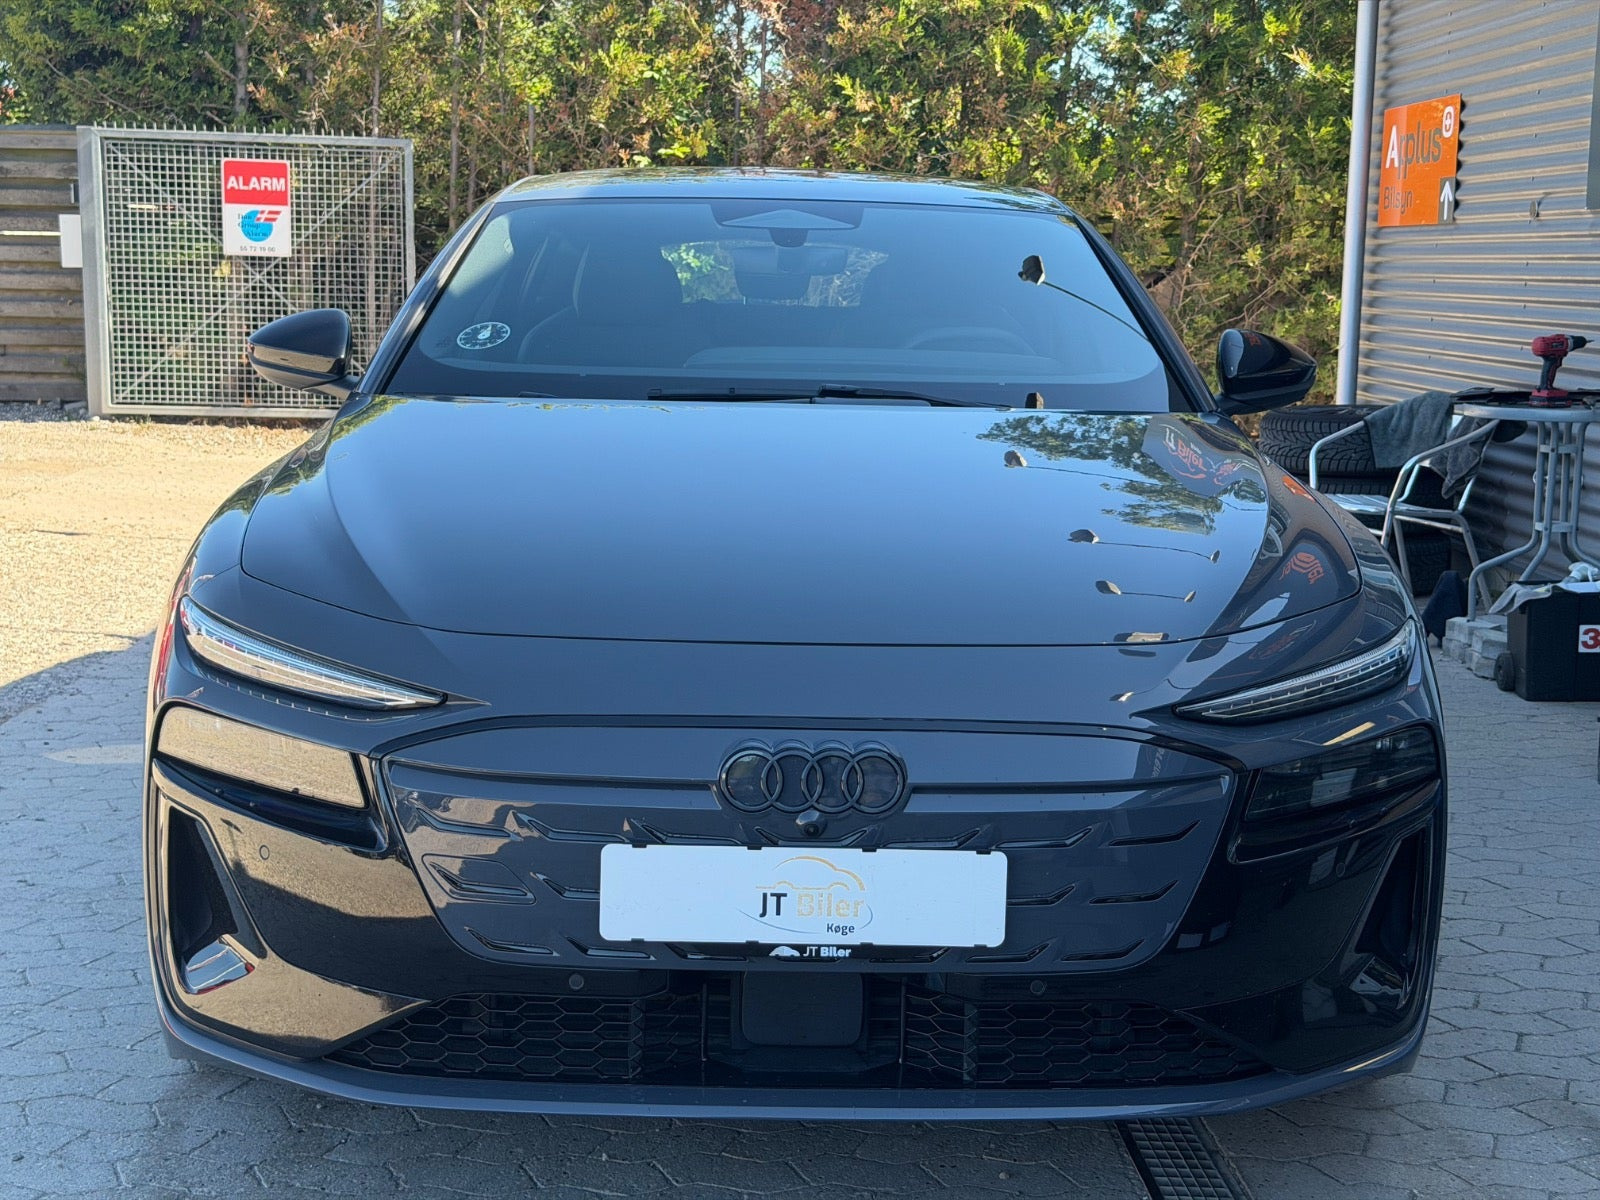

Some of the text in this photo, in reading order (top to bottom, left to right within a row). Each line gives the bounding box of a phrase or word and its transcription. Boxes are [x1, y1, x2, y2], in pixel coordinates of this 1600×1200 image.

[226, 175, 285, 192] ALARM
[1383, 186, 1413, 215] Bilsyn
[759, 892, 865, 918] JT Biler
[826, 922, 855, 936] Køge
[803, 946, 852, 957] JT Biler
